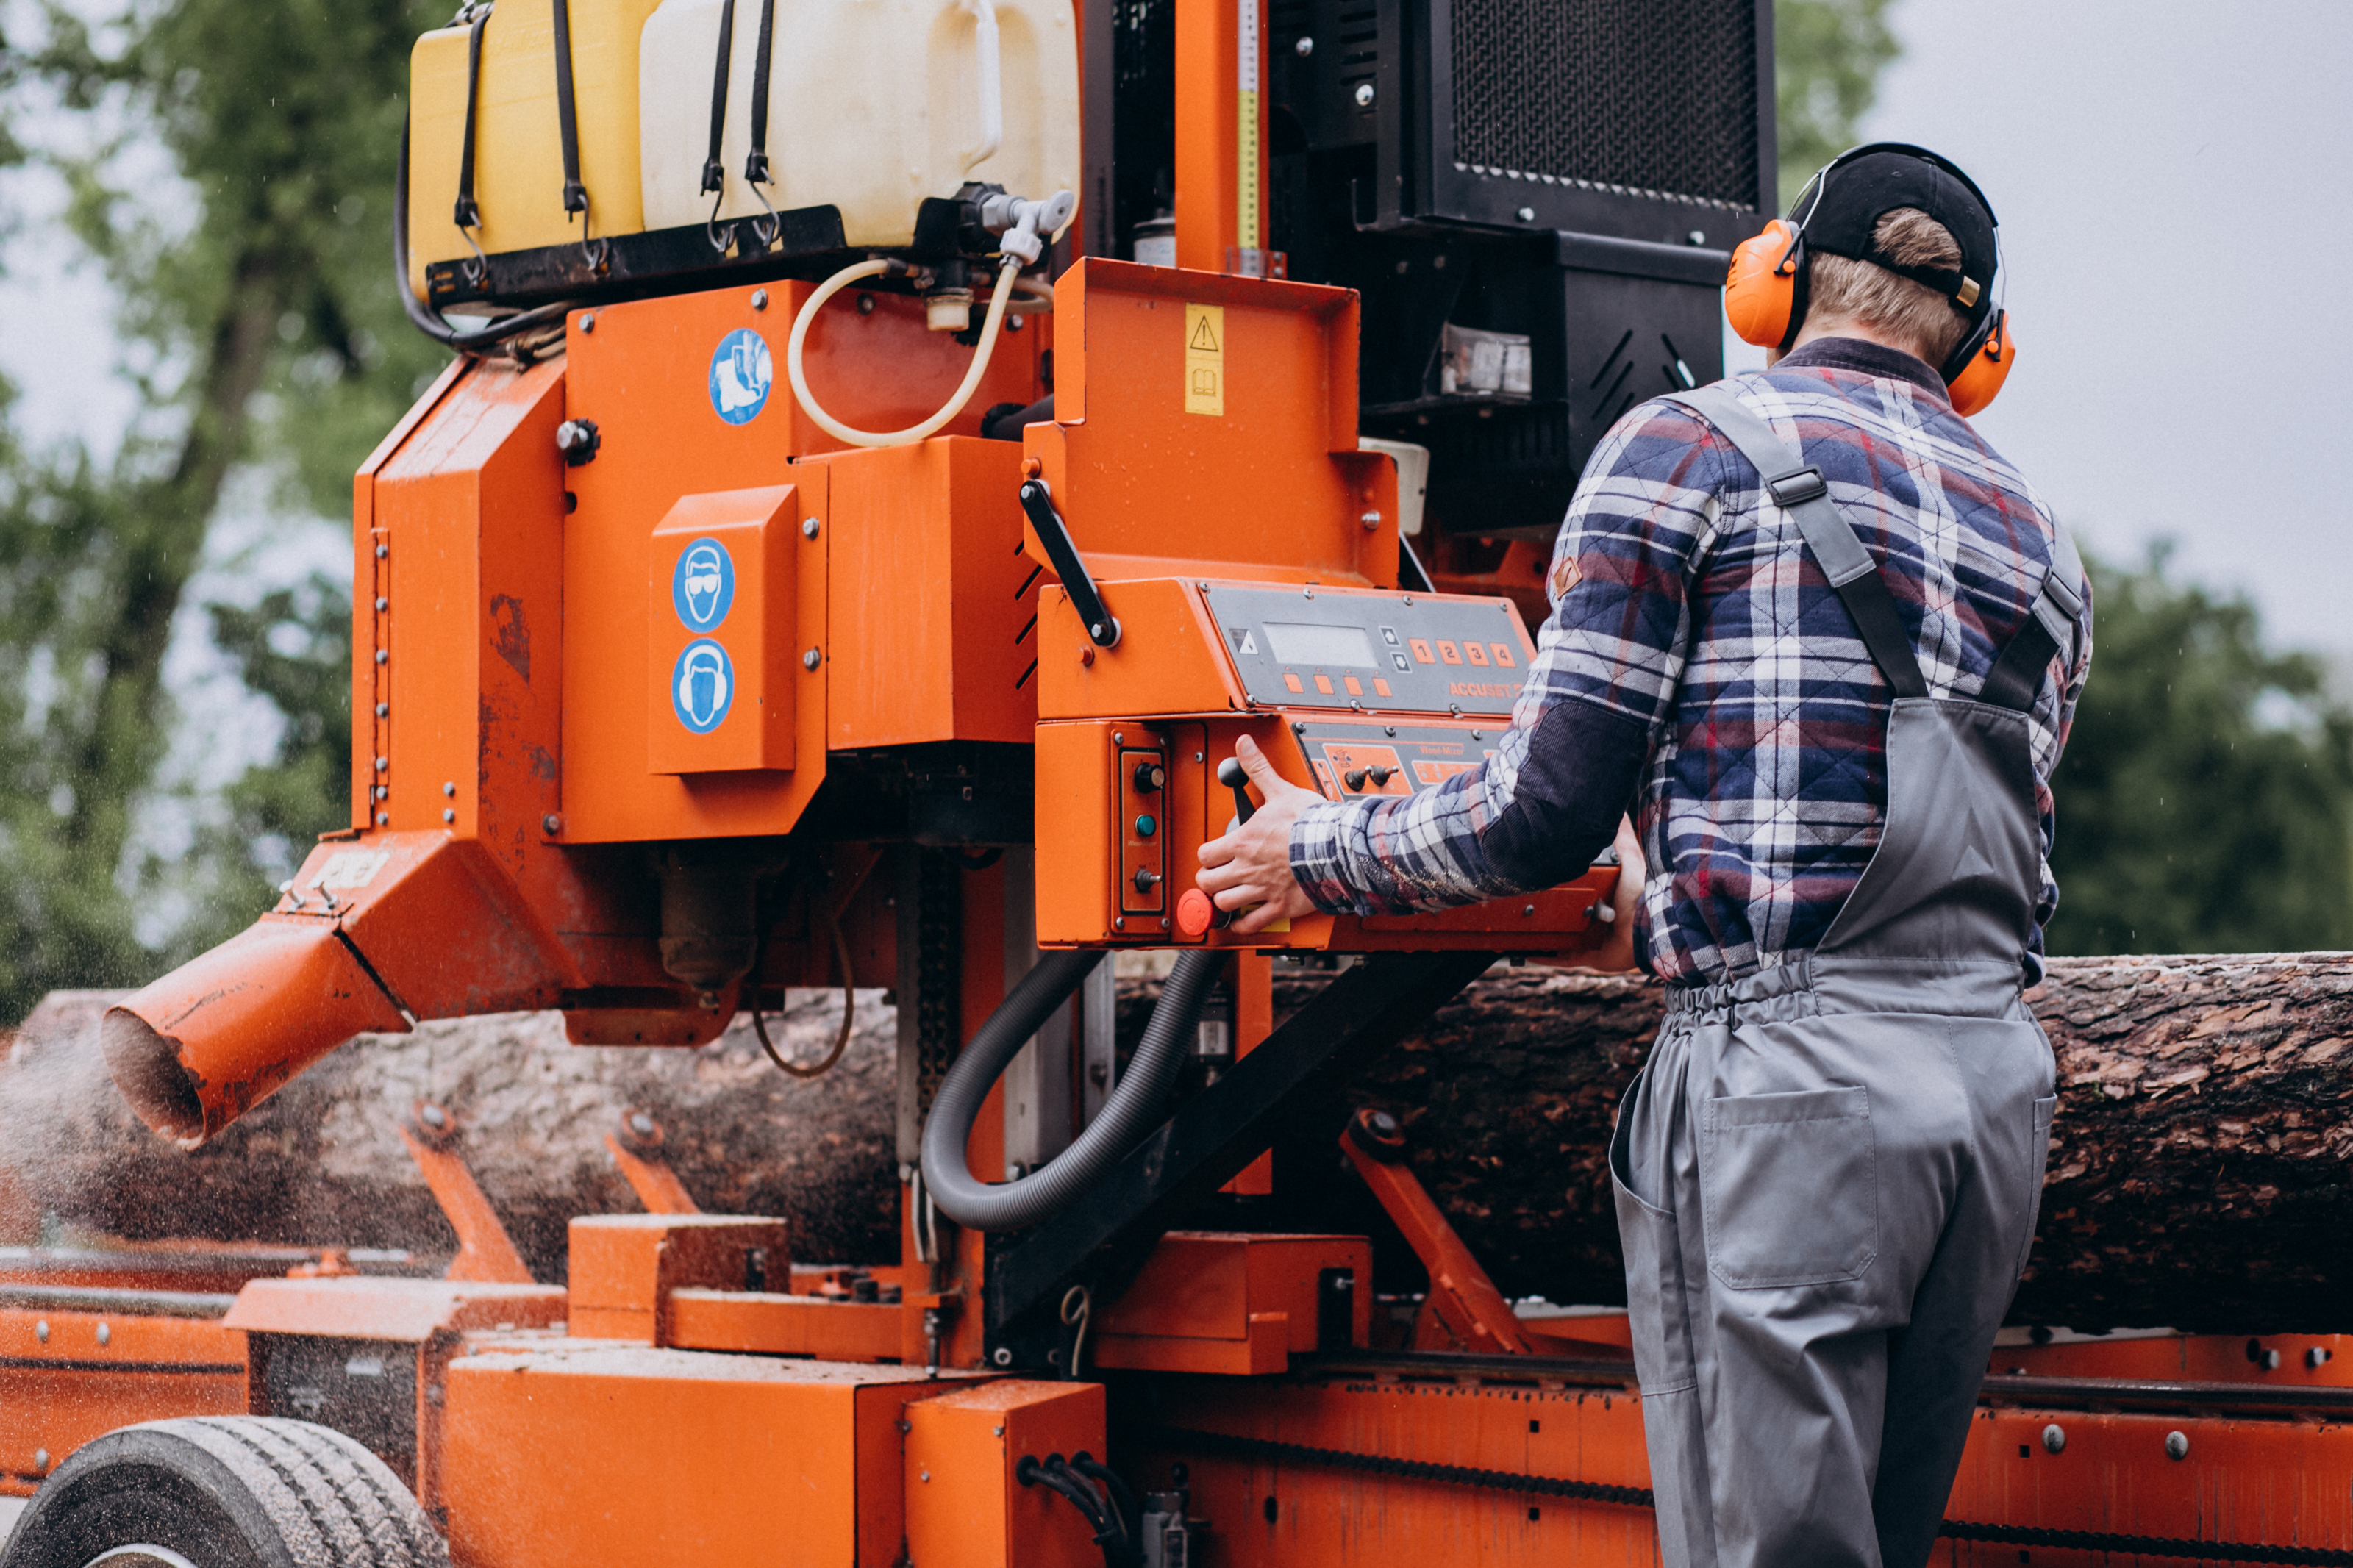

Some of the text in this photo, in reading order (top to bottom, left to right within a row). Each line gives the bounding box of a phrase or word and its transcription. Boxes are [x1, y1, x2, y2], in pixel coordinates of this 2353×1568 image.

[1418, 645, 1508, 661] 1 2 3 4
[1449, 682, 1511, 698] ACCUSET
[1419, 745, 1464, 756] Wood-Mizer
